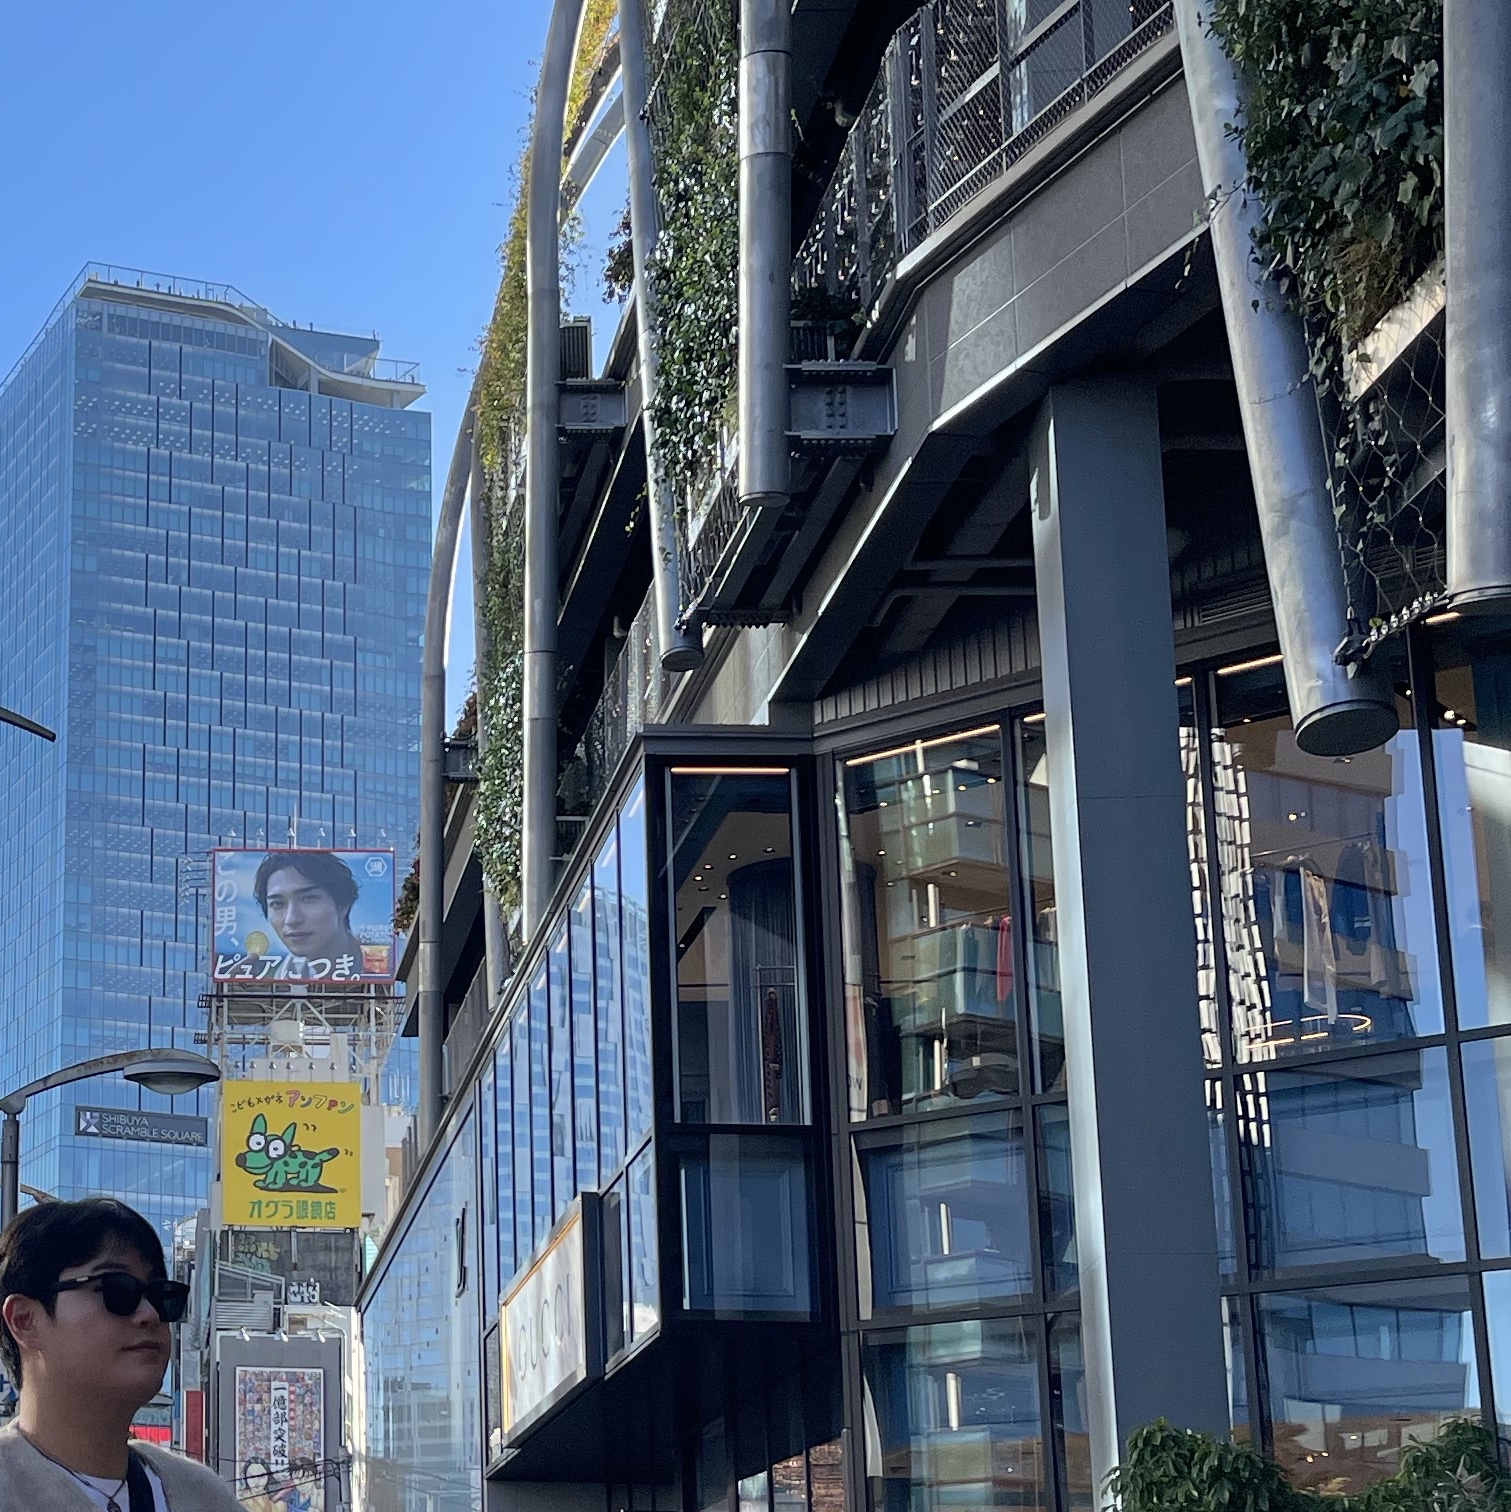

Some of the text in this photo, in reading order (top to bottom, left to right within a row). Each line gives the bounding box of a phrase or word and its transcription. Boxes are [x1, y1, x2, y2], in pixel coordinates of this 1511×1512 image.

[214, 953, 361, 980] ピュアにつき。
[101, 1112, 149, 1127] SHIBUYA
[101, 1123, 204, 1141] SCRAMBLE SQUARE
[249, 1199, 336, 1220] オグラ眼鏡店
[518, 1272, 571, 1381] GUCCI
